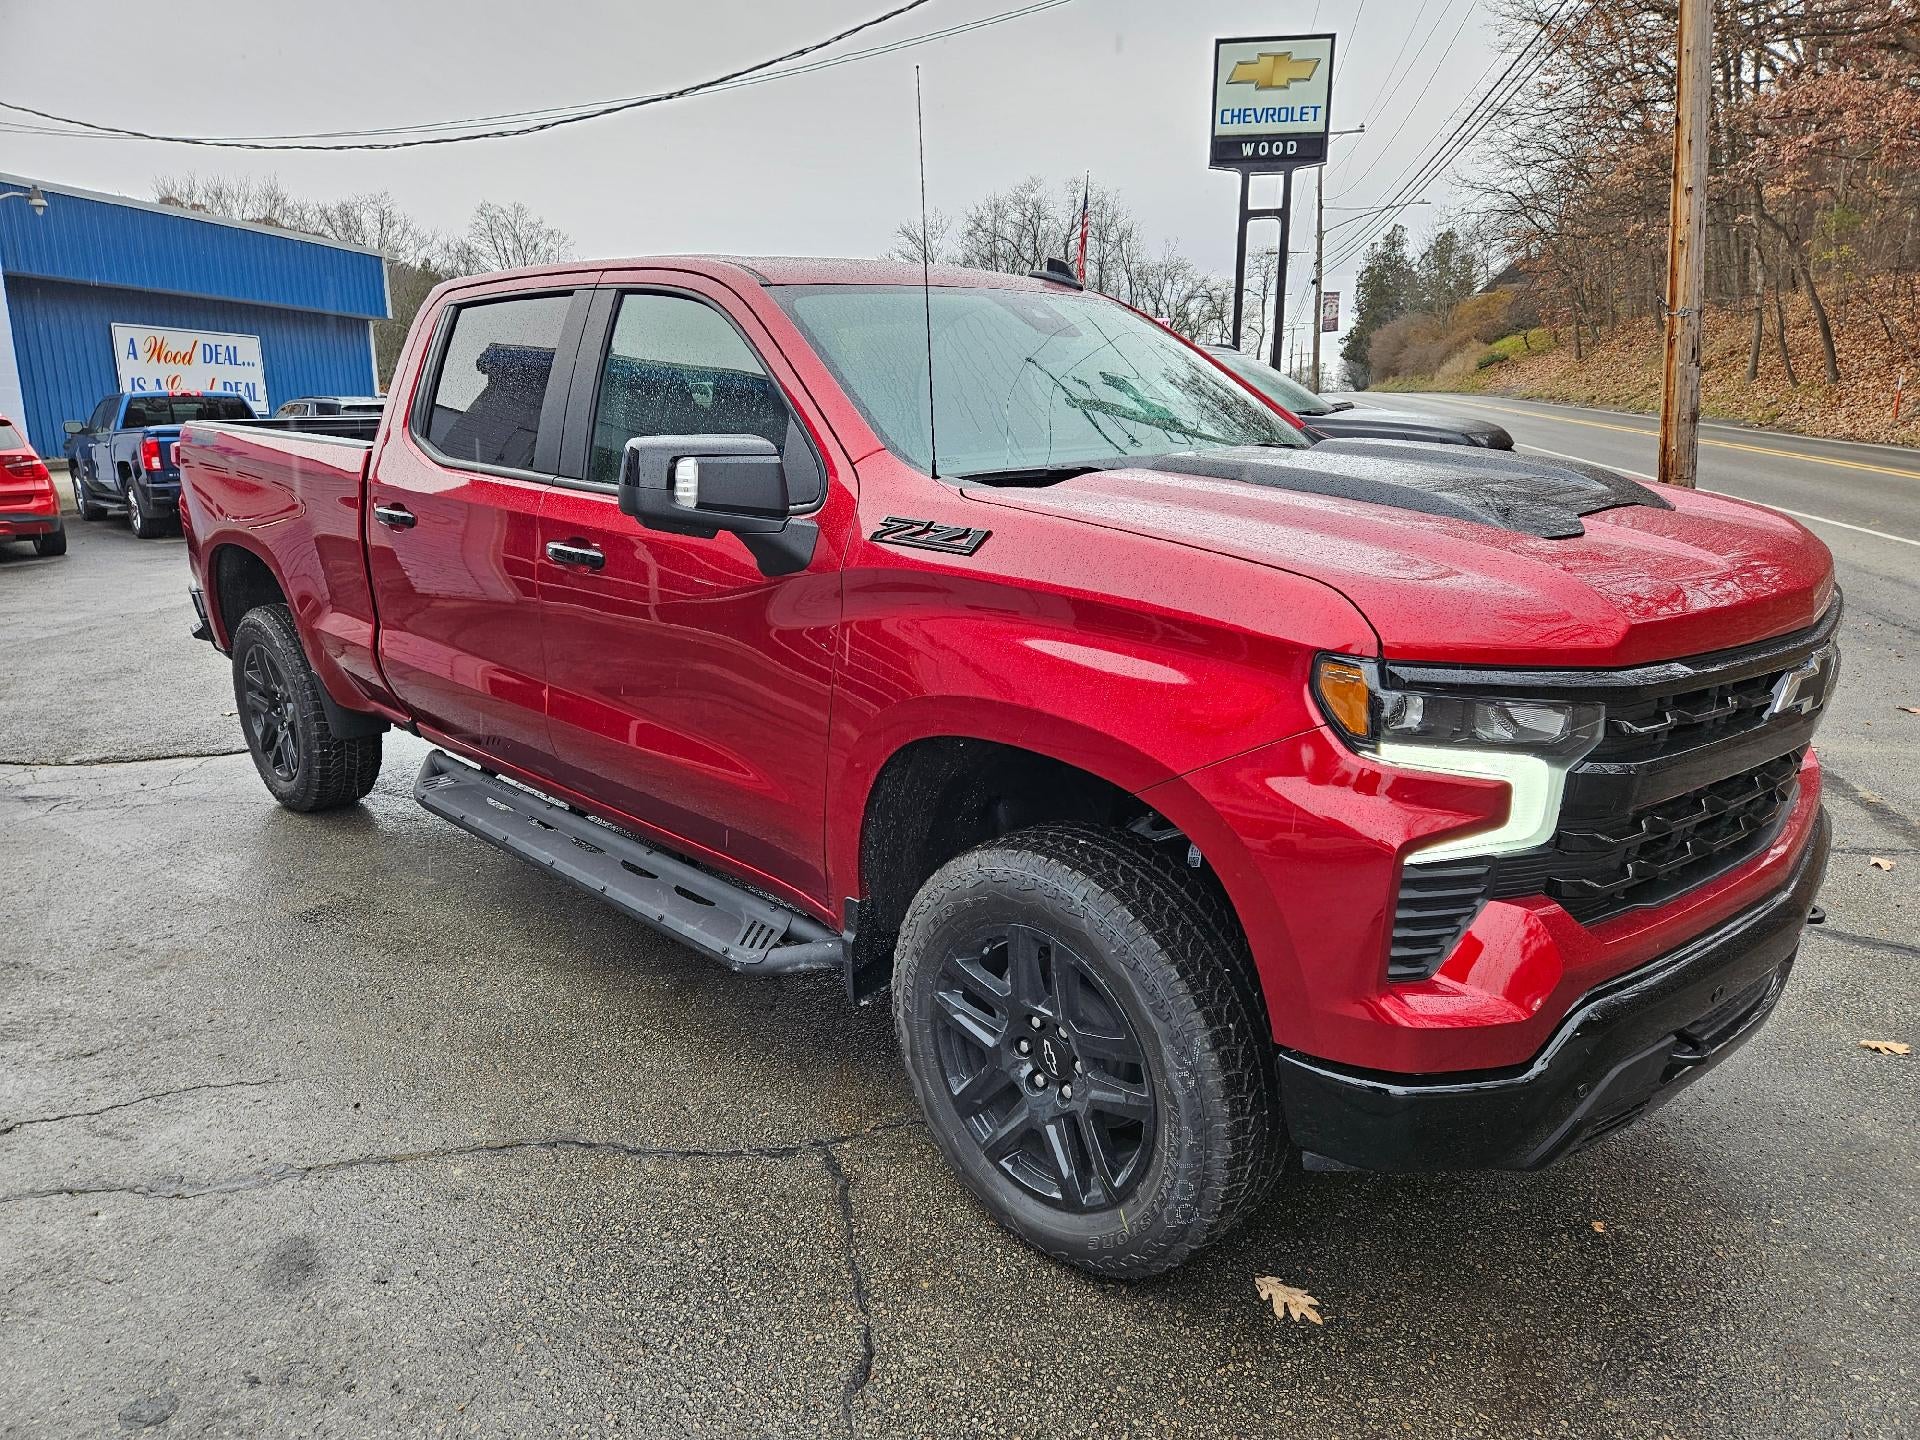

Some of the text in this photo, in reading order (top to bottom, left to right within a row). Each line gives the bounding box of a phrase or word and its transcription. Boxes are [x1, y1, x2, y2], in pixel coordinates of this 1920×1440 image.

[1220, 105, 1321, 125] CHEVROLET
[1241, 141, 1297, 157] WOOD
[126, 335, 256, 368] A Wood DEAL...
[868, 516, 993, 557] Z71
